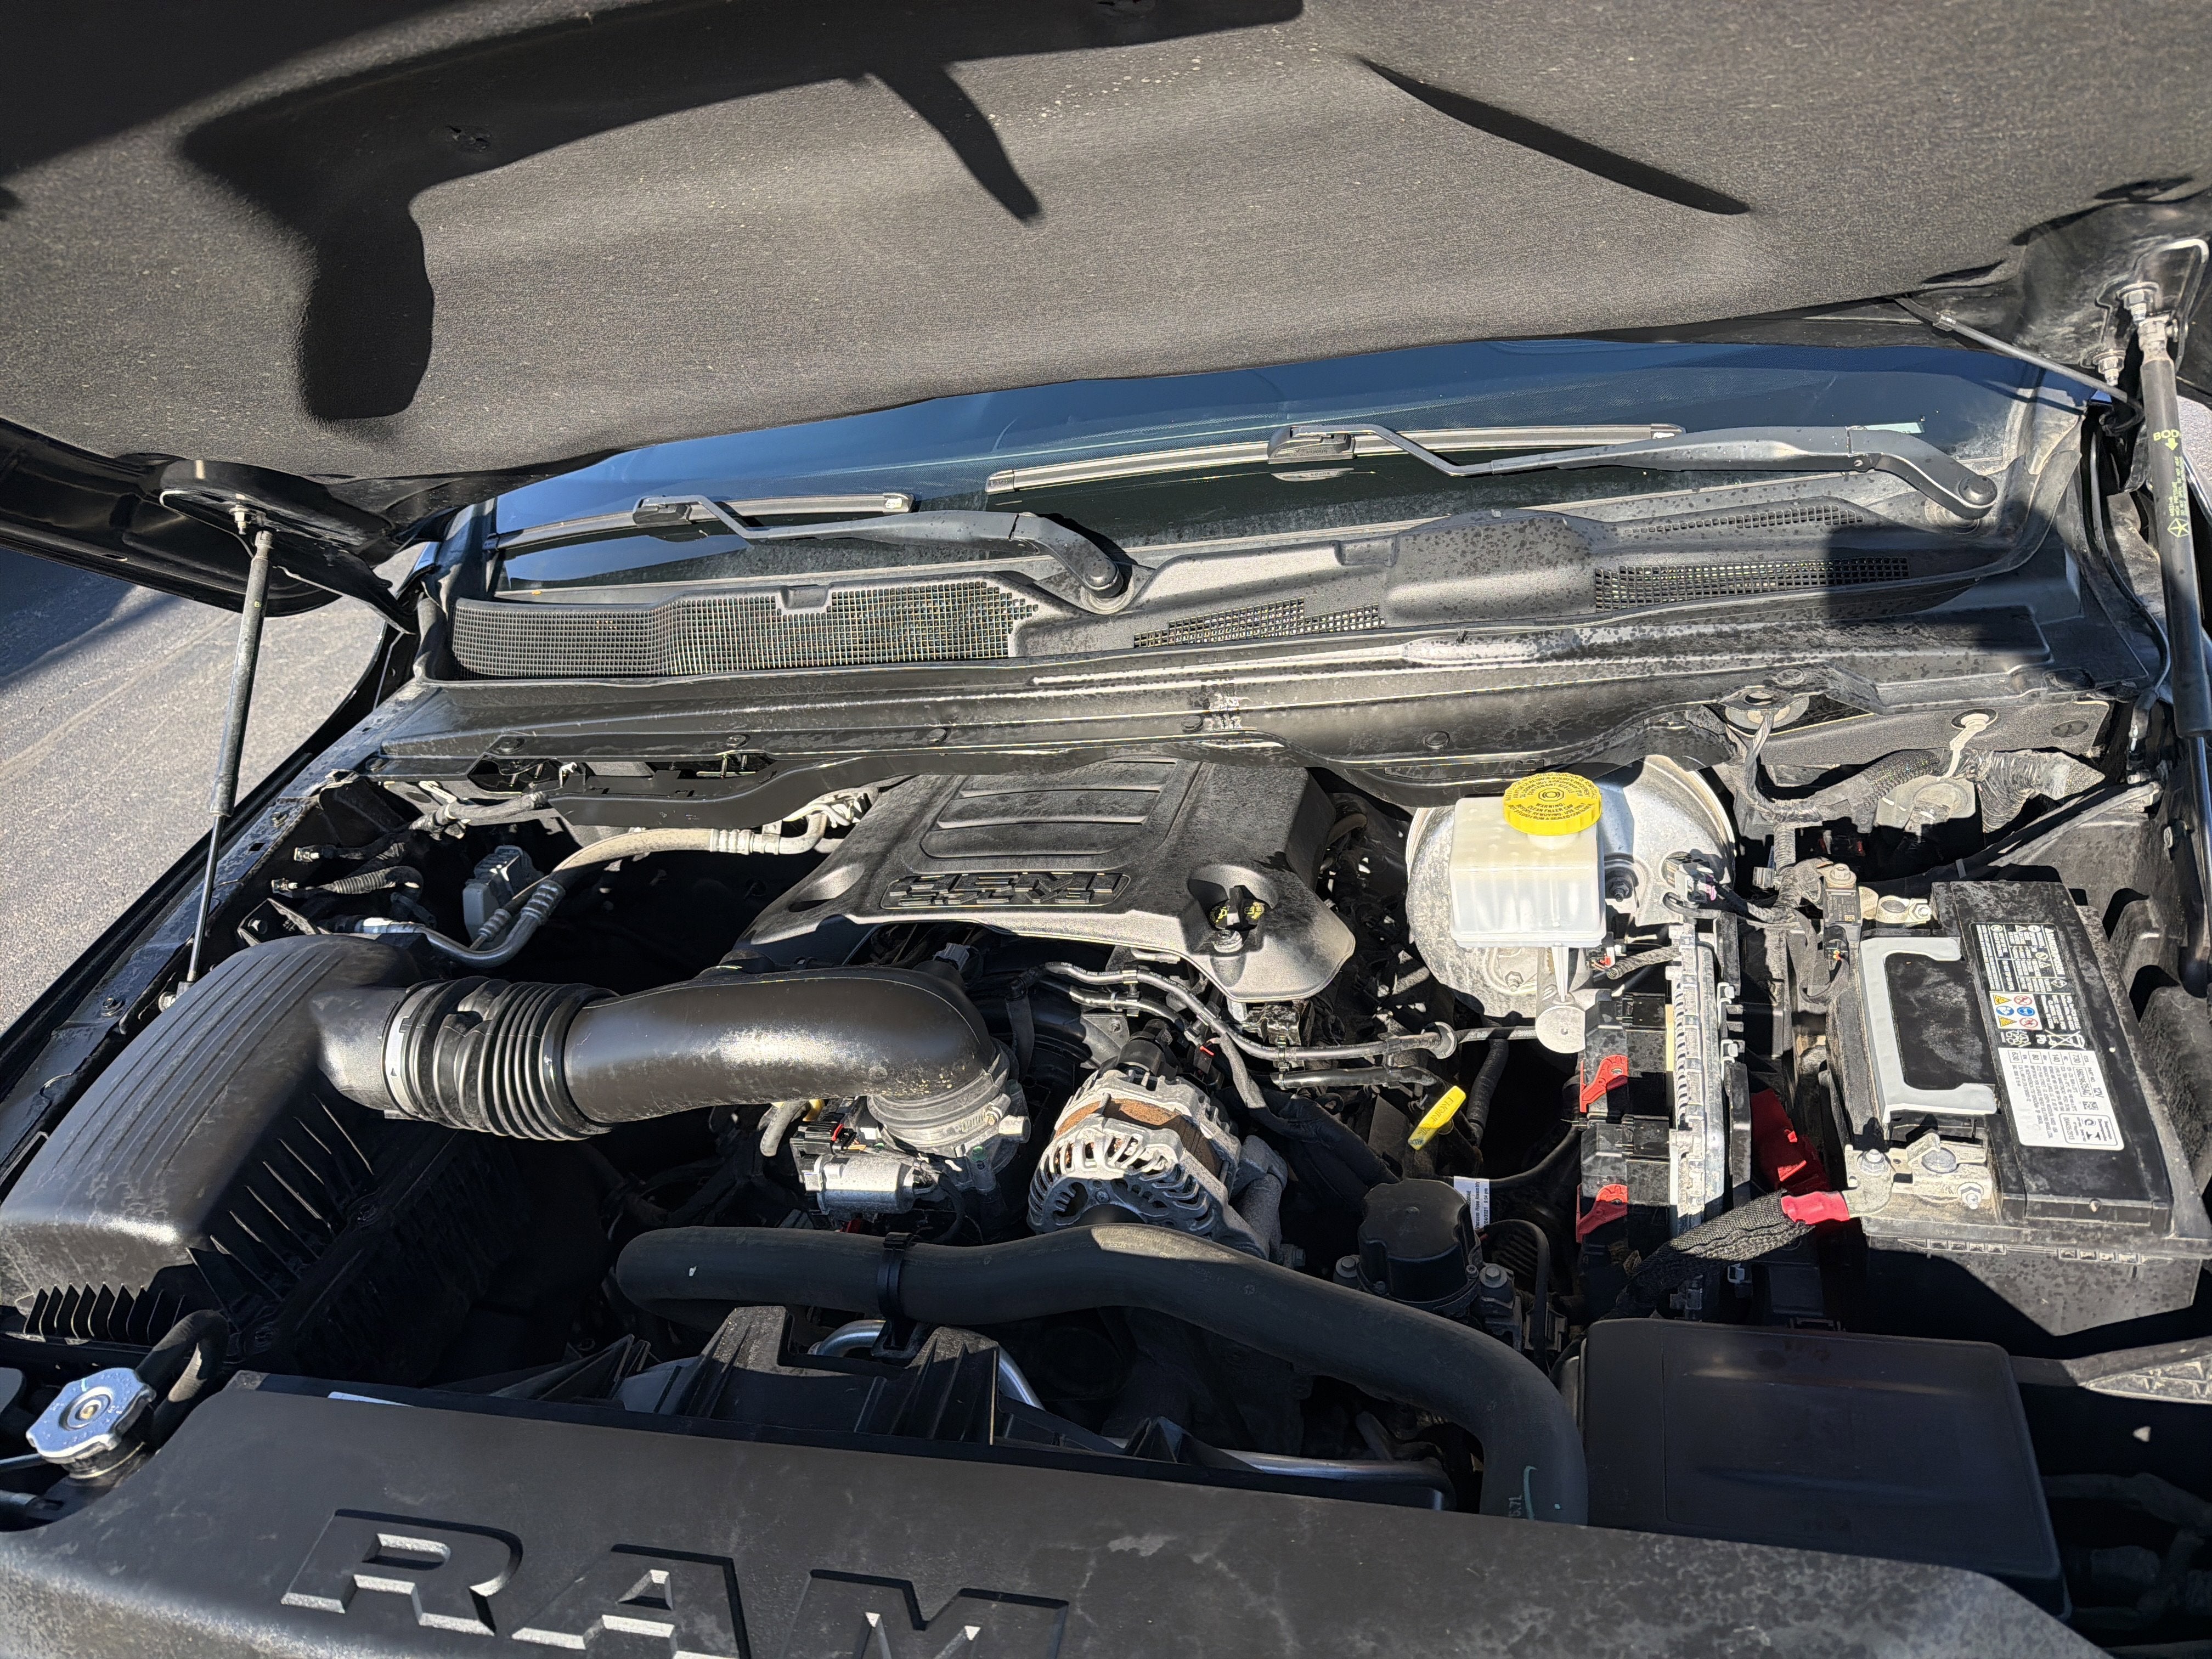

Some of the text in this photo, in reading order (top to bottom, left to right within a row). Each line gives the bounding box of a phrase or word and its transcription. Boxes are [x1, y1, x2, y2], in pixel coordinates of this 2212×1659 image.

[2153, 429, 2181, 441] BOD
[889, 872, 1124, 896] HEMI
[1024, 890, 1092, 905] V8
[2045, 933, 2066, 975] DANGER/POISON
[2035, 1034, 2047, 1044] Pb
[2011, 1052, 2019, 1060] 630
[2051, 1054, 2061, 1062] 140
[2072, 1054, 2081, 1063] 730
[2092, 1087, 2104, 1098] 12V
[281, 1508, 1070, 1659] RAM
